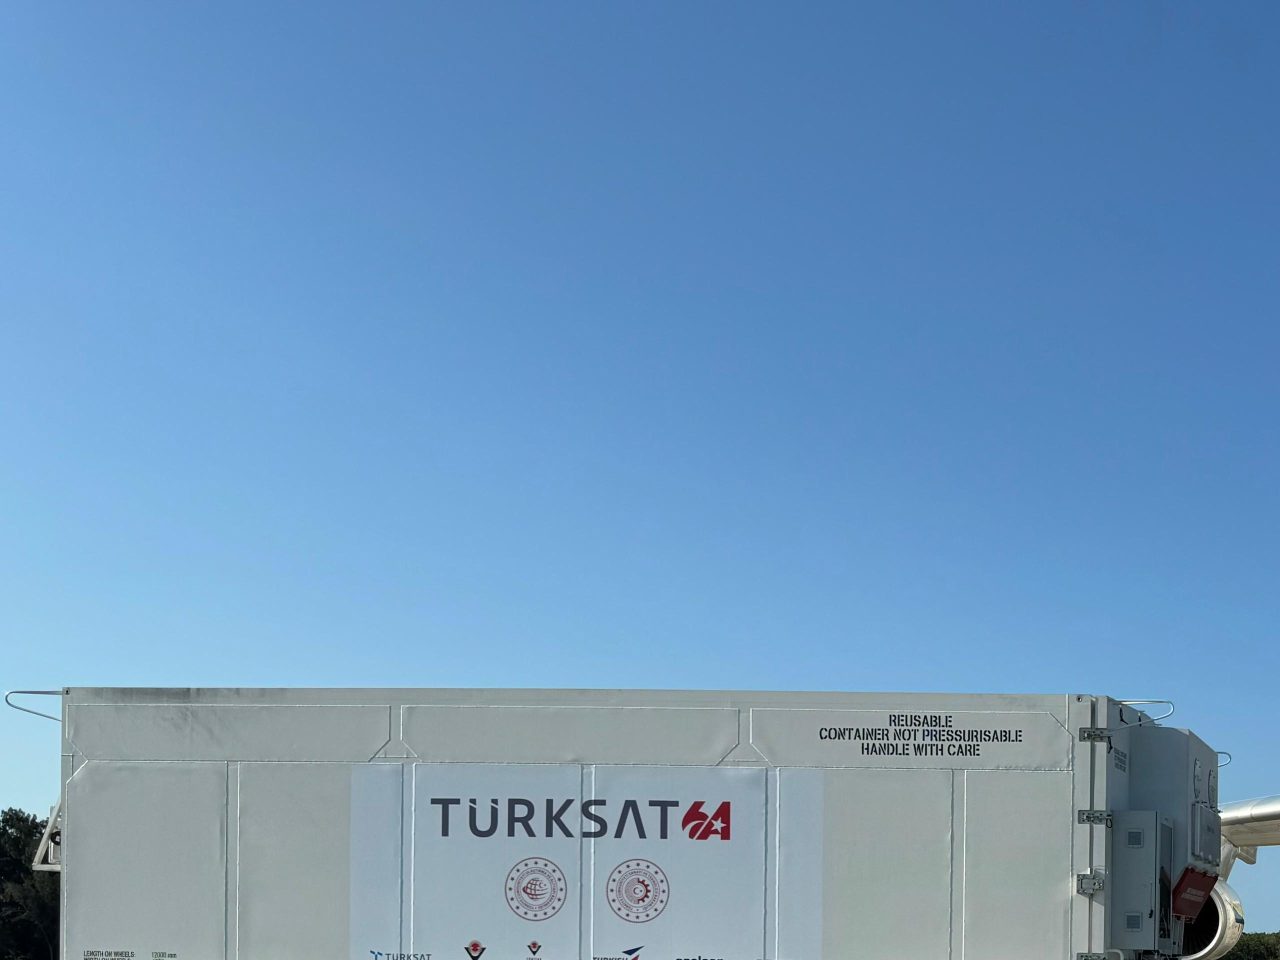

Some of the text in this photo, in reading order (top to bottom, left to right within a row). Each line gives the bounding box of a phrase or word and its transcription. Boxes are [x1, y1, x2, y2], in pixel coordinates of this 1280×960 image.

[889, 714, 953, 728] REUSABLE
[819, 728, 1023, 742] CONTAINER NOT PRESSURISABLE
[861, 743, 980, 756] HANDLE WITH CARE
[430, 798, 679, 840] TÜRKSAT
